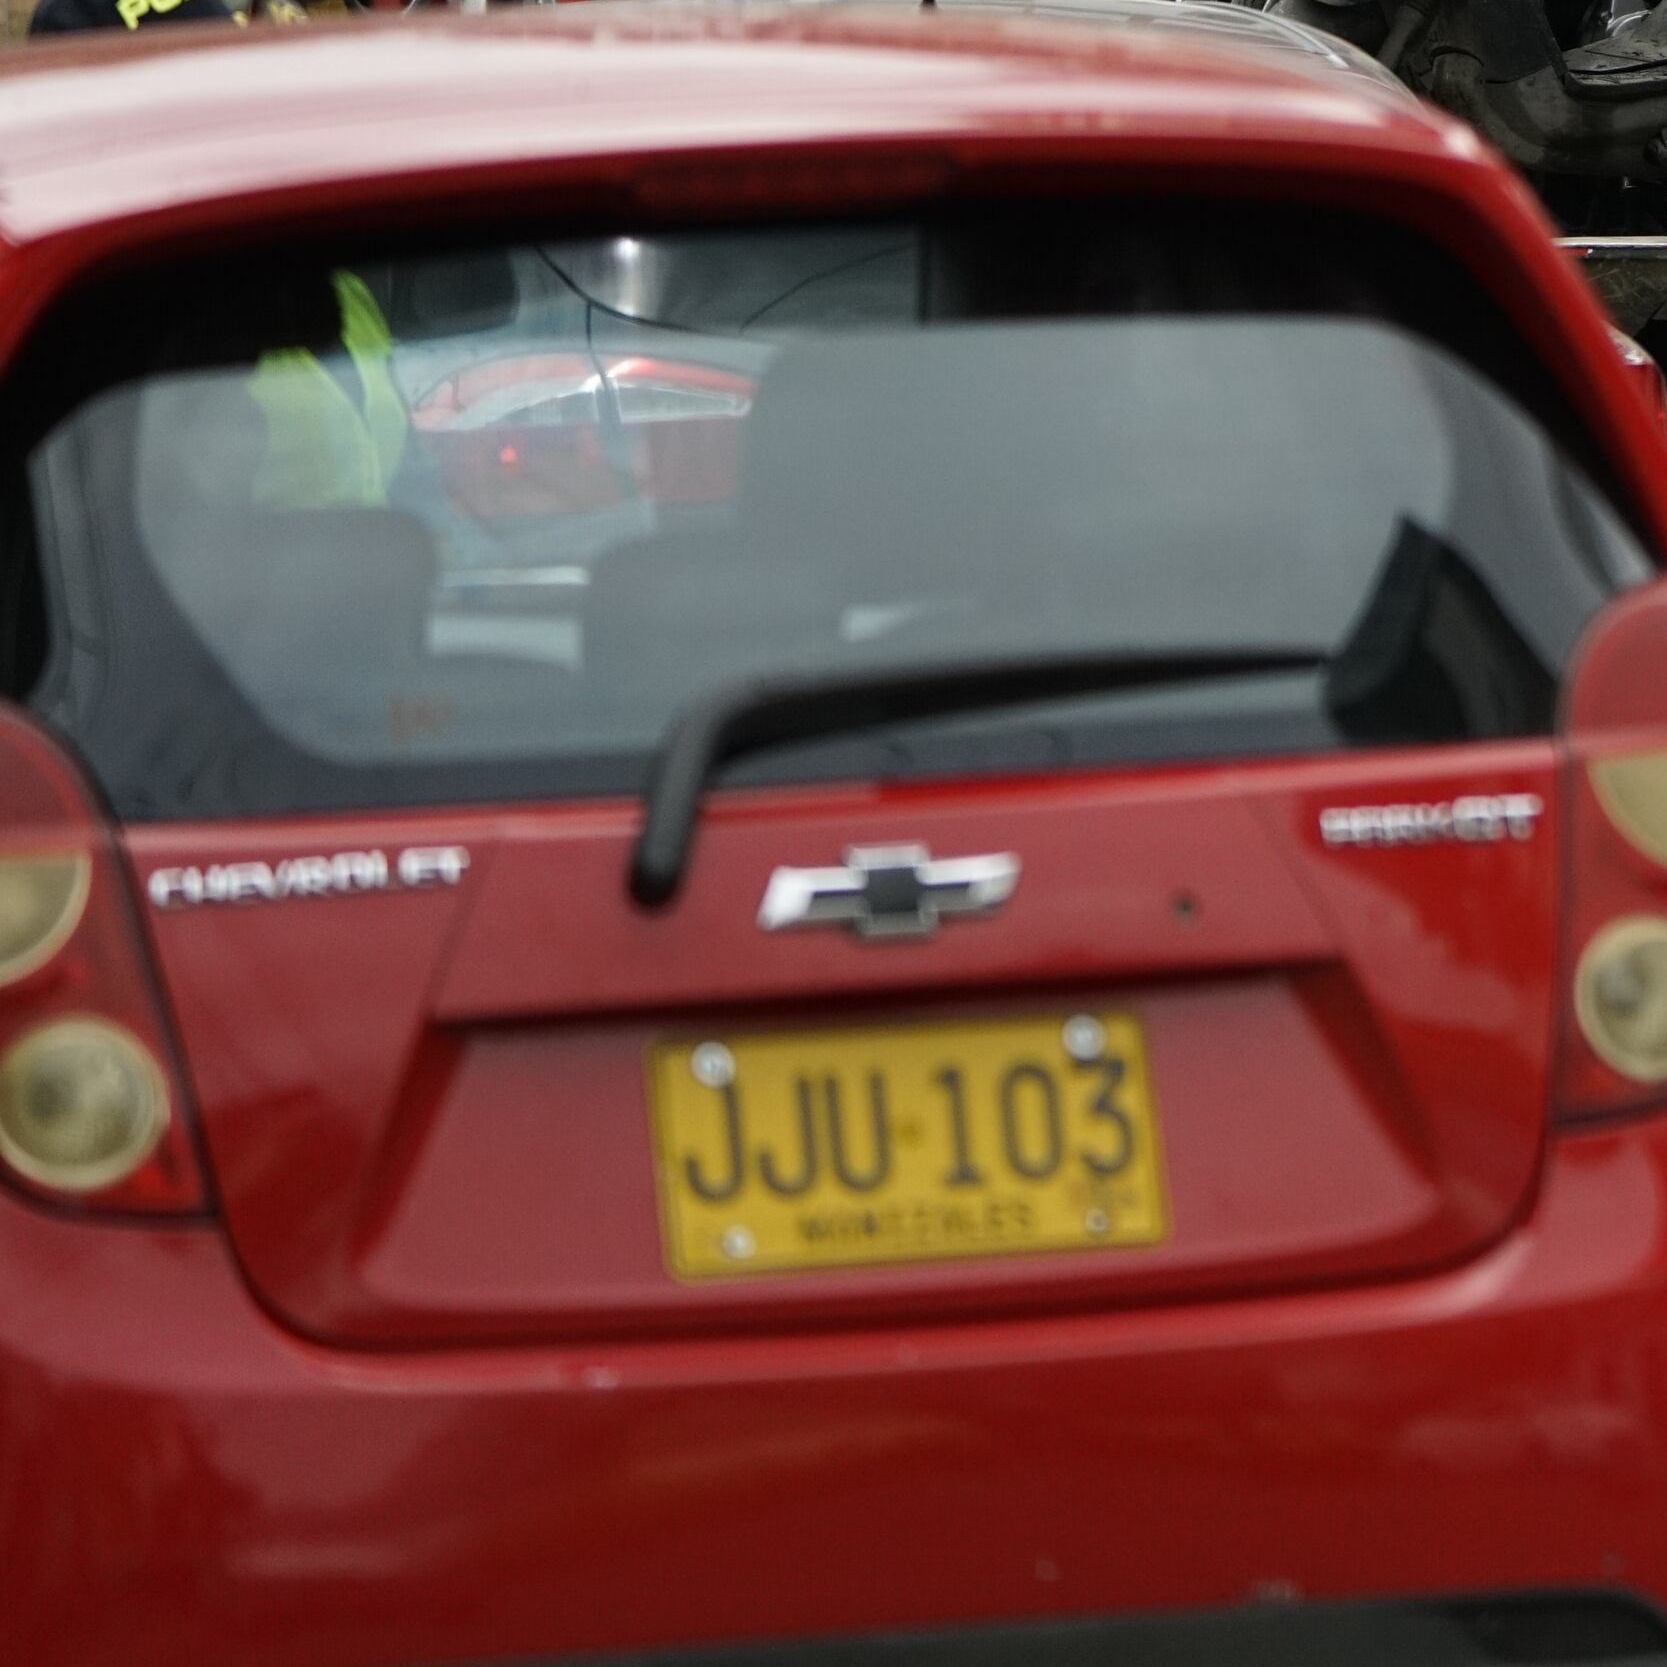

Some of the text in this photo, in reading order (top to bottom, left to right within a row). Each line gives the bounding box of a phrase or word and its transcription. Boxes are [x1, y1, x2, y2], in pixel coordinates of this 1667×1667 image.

[148, 845, 471, 907] CHEVROLET
[686, 1057, 1134, 1202] JJU 103
